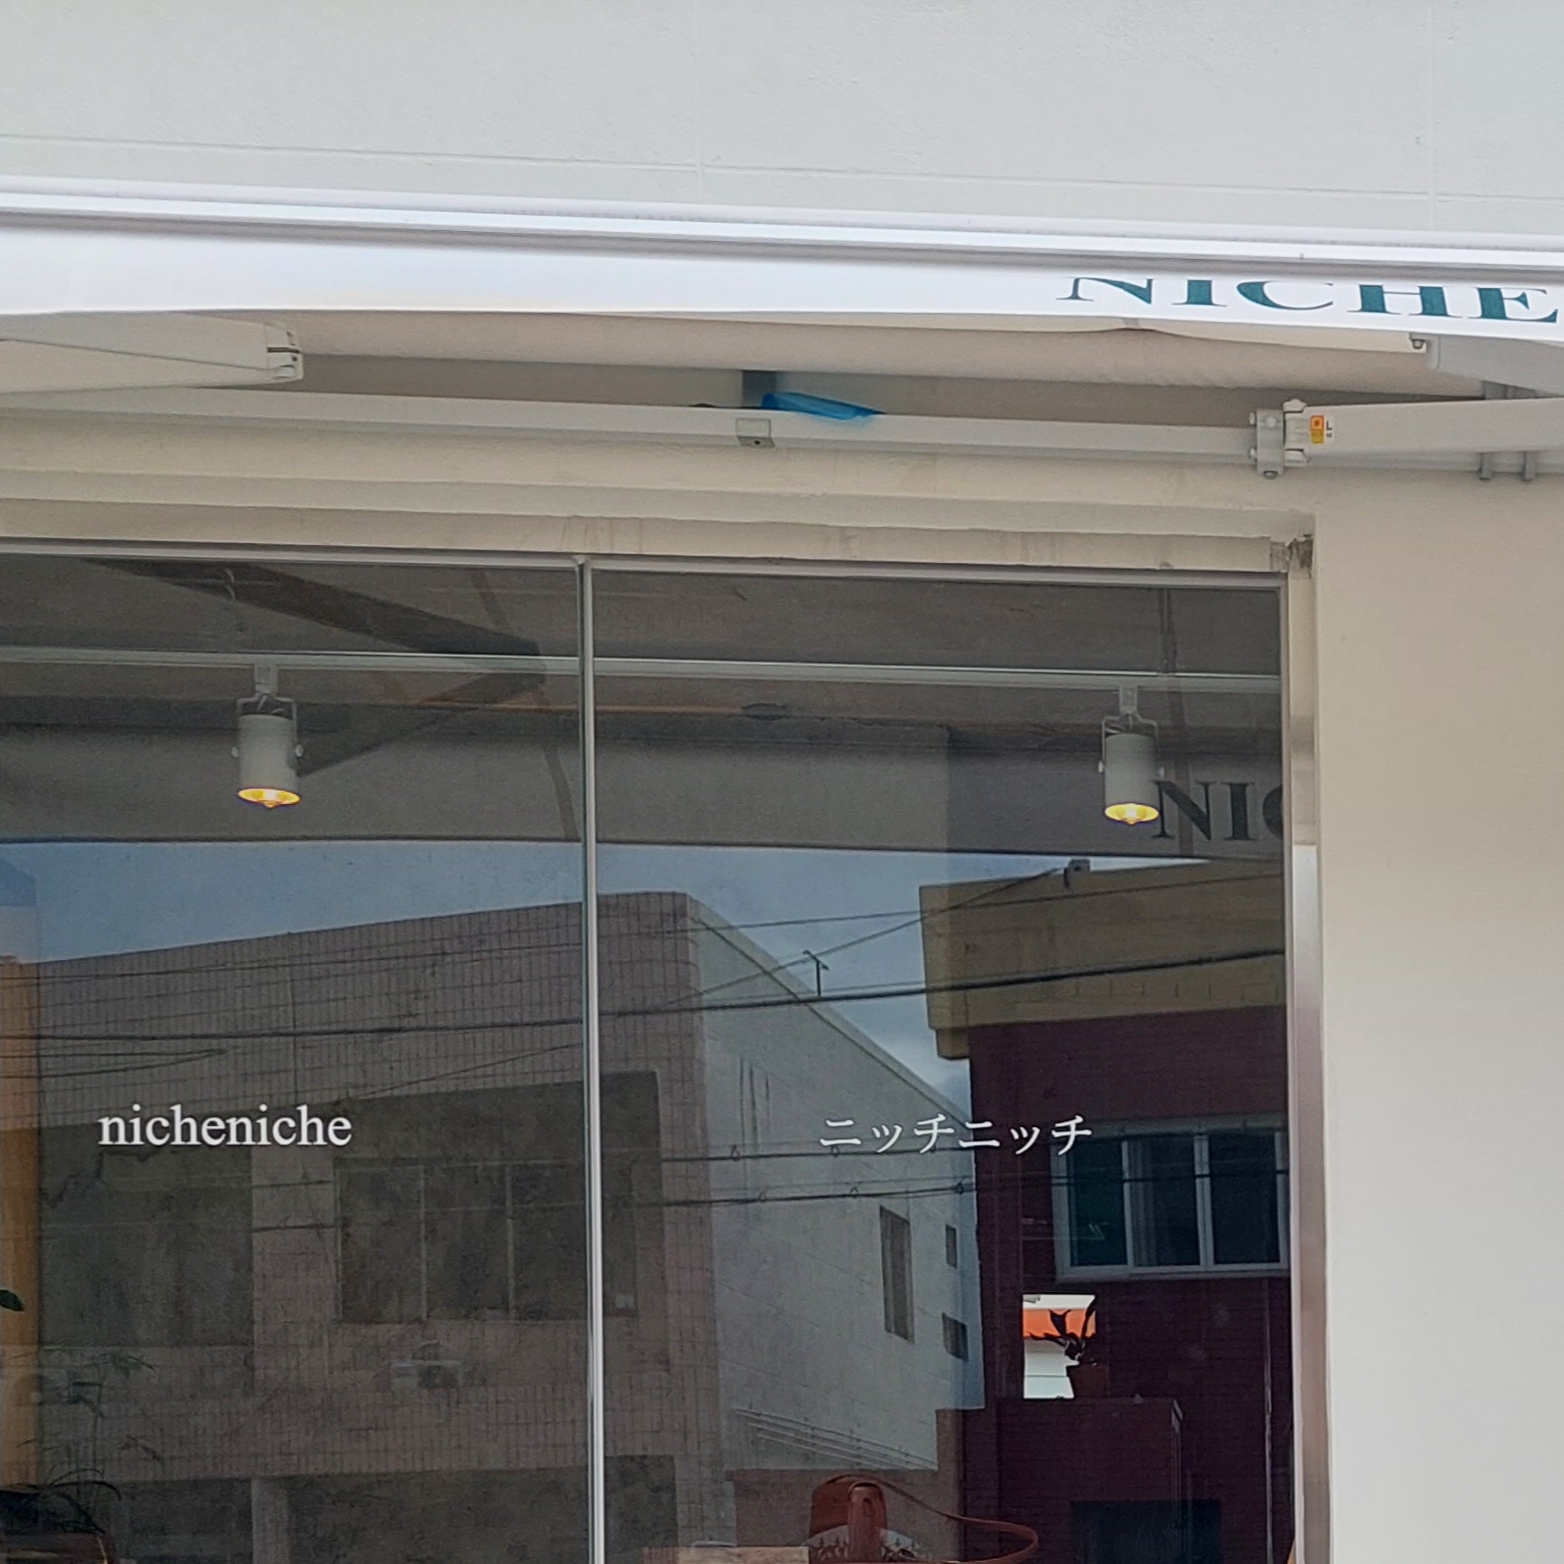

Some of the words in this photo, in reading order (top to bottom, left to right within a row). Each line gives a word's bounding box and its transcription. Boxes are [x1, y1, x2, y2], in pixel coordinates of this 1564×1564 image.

[1055, 276, 1559, 324] NICHE
[98, 1104, 352, 1146] nicheniche
[819, 1113, 1093, 1156] ニッチニッチ
